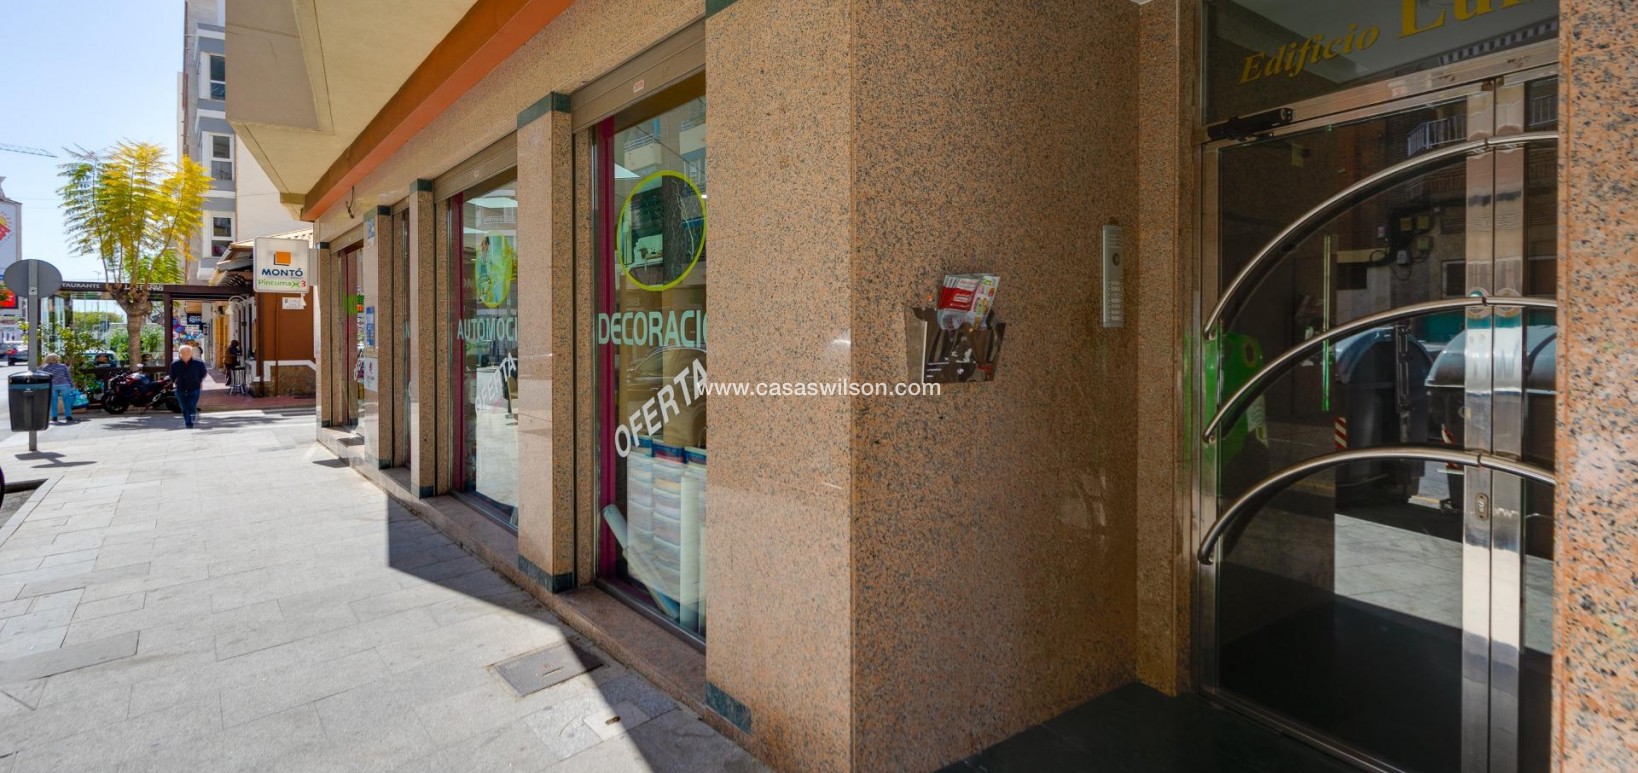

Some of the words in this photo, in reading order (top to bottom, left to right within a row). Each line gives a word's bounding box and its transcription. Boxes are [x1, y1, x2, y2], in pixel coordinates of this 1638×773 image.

[1236, 23, 1380, 87] Edificio
[261, 268, 304, 277] MONTÓ
[598, 310, 707, 347] DECORACI
